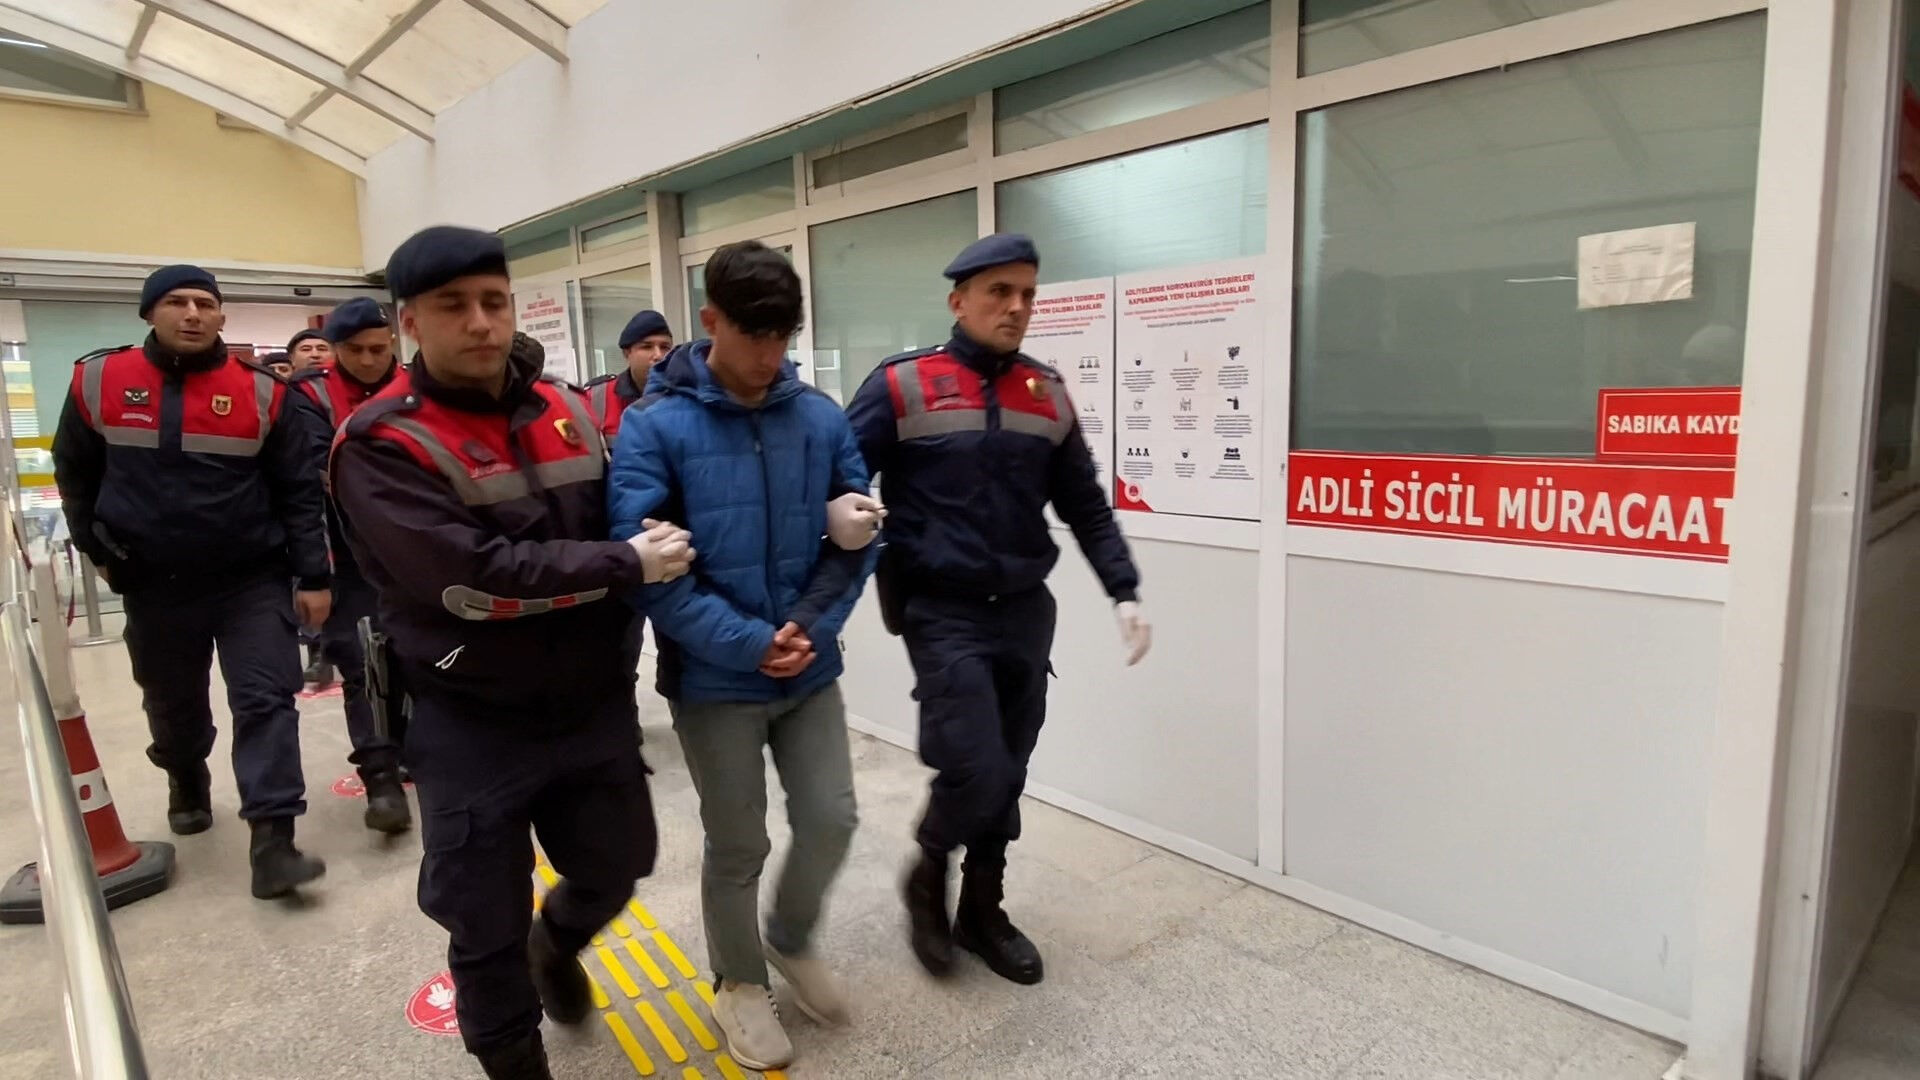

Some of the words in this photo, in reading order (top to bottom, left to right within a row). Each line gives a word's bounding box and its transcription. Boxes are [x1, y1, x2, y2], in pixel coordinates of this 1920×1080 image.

[1607, 414, 1682, 434] SABIKA
[1297, 468, 1374, 517] ADLİ
[1384, 470, 1484, 527] SİCİL
